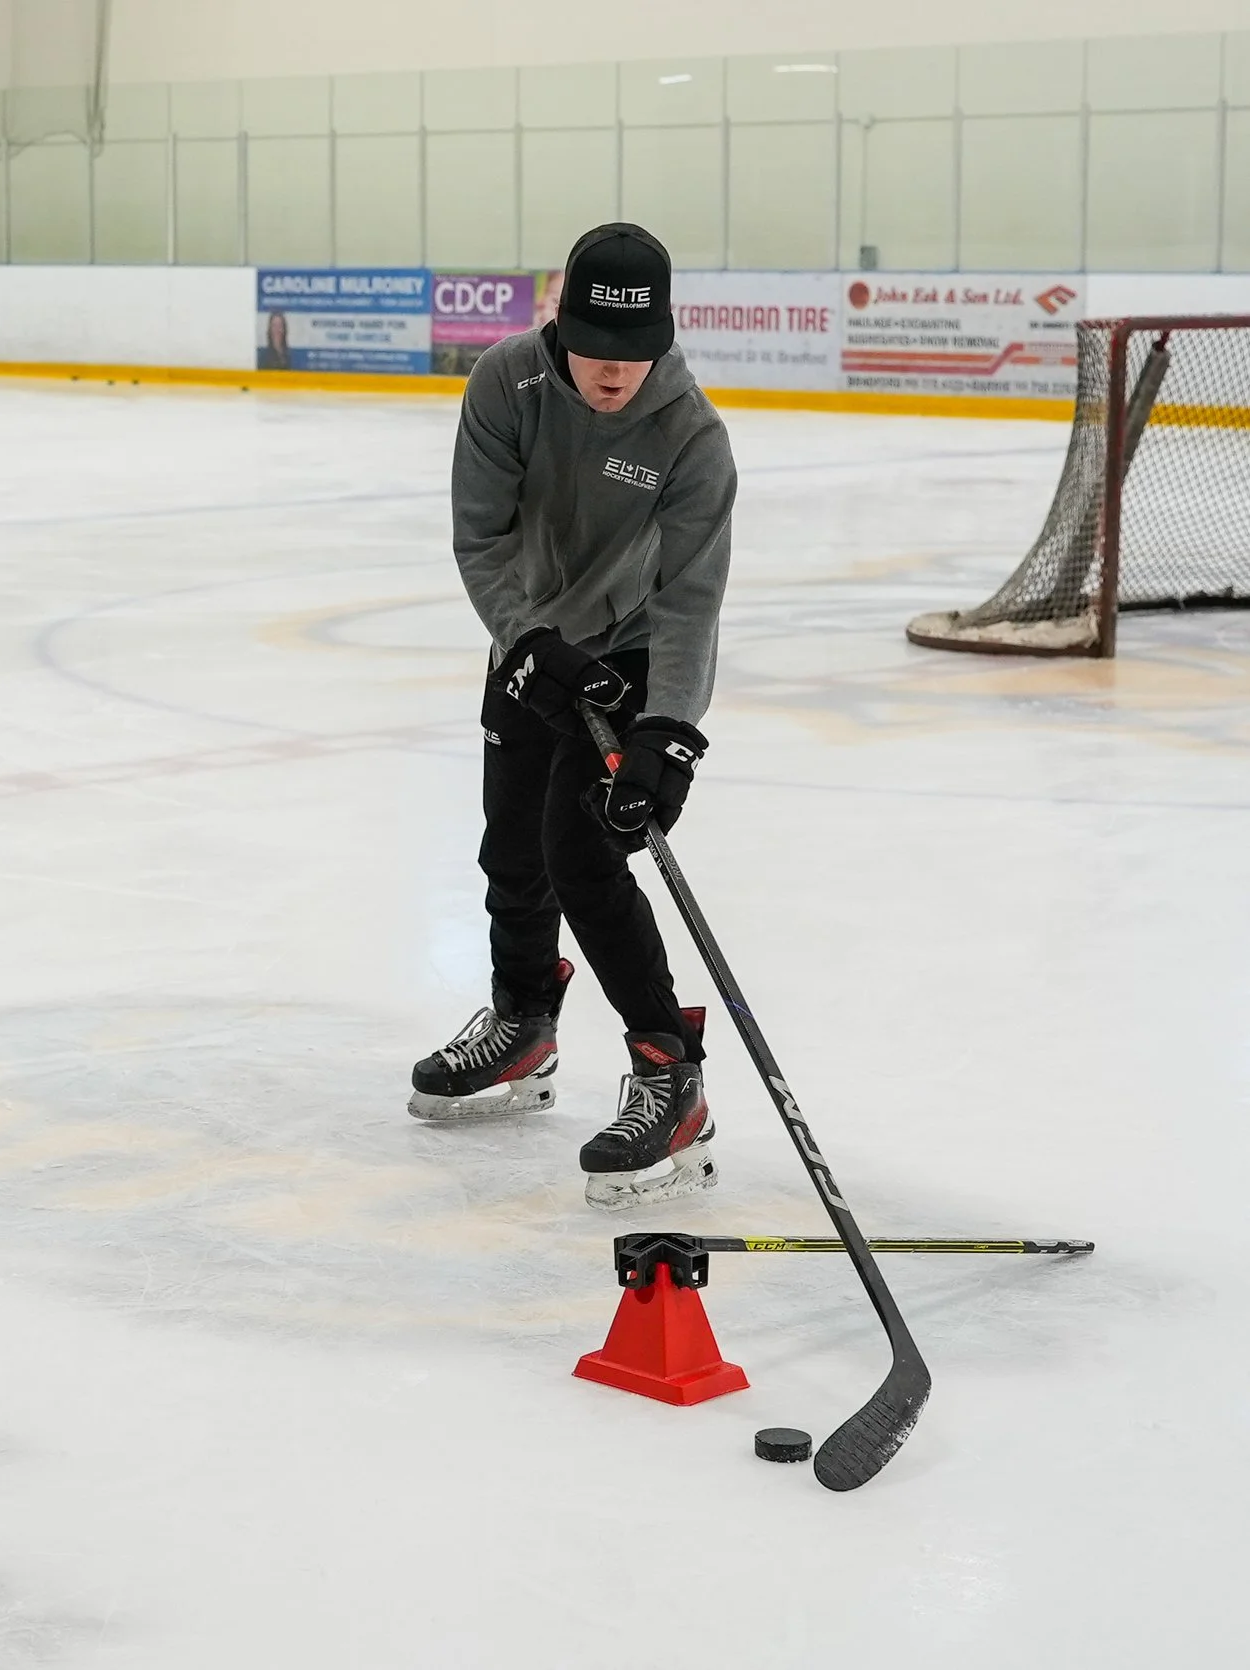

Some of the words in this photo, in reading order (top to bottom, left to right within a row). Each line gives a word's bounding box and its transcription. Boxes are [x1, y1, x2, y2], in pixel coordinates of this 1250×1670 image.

[434, 280, 514, 315] CDCP
[590, 282, 651, 303] ELITE
[874, 286, 909, 305] John
[962, 288, 989, 305] Son
[589, 299, 611, 308] HOCKEY
[612, 302, 651, 310] DEVELOPMENT
[678, 303, 780, 332] CANADIAN
[786, 305, 831, 333] TIRE
[602, 471, 625, 484] HOCKEY
[604, 457, 660, 486] ELITE
[583, 679, 610, 692] CCM
[619, 799, 648, 813] CCM
[768, 1073, 850, 1213] CCM
[752, 1242, 786, 1251] CCM
